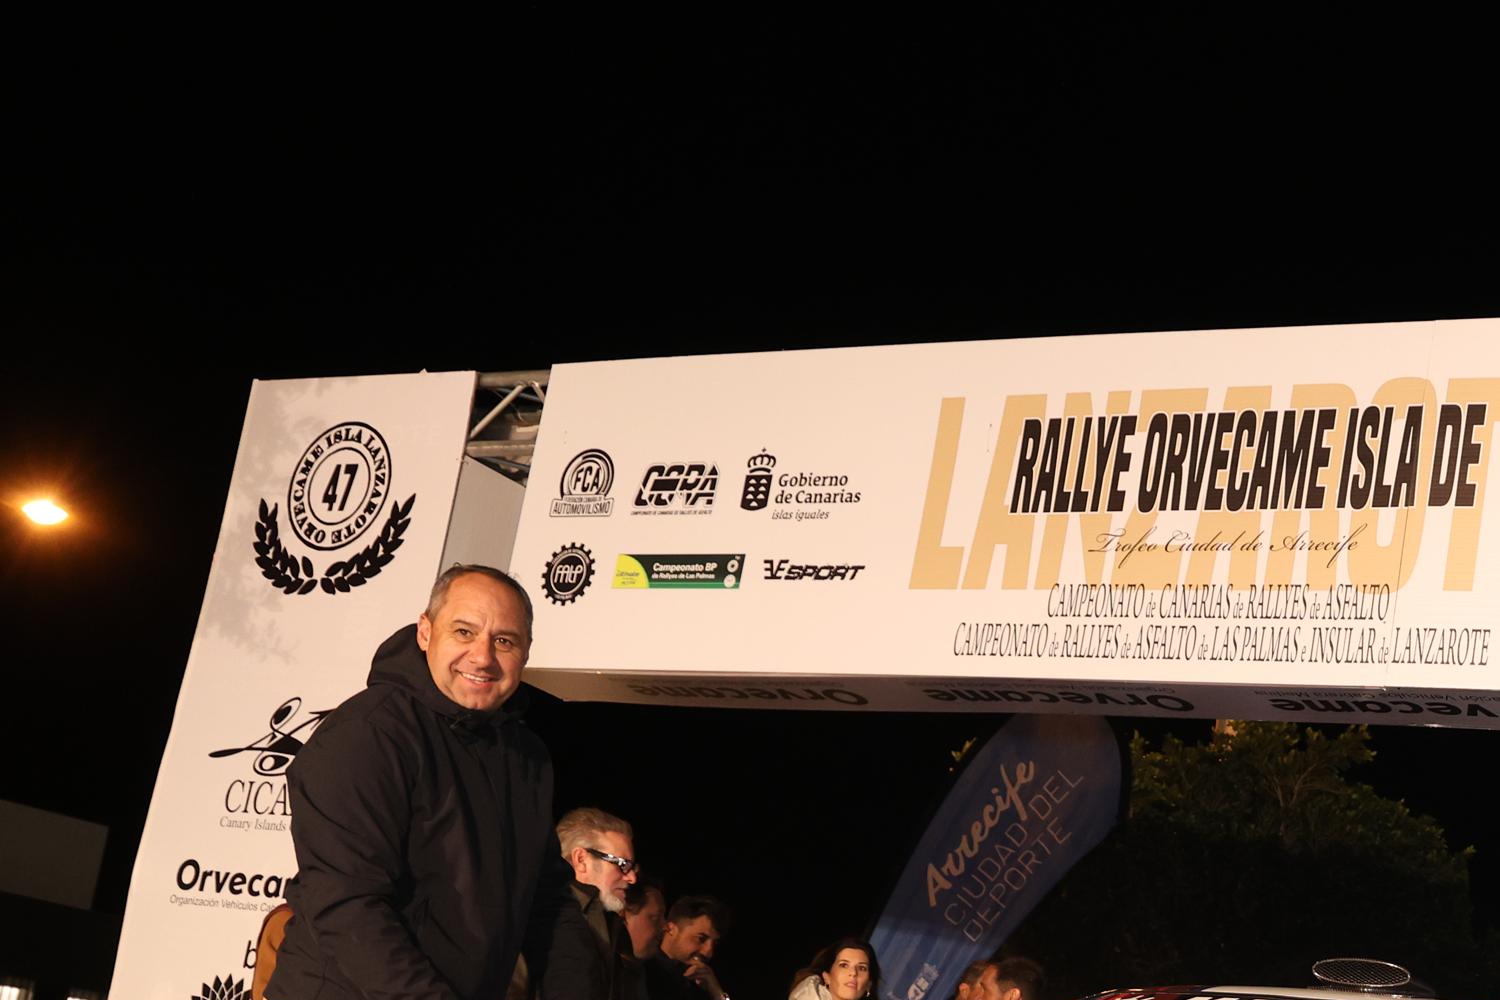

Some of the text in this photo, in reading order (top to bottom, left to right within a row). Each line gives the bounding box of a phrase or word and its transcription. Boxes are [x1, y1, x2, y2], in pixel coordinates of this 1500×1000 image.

[325, 428, 363, 449] ISLA
[1010, 402, 1488, 513] RALLYE ORVECAME ISLA DE
[322, 463, 359, 512] 47
[573, 465, 601, 493] FCA
[778, 472, 848, 488] Gobierno
[552, 500, 611, 514] AUTOMOVILISMO
[775, 488, 861, 504] de Canarias
[772, 509, 829, 521] islas iguales
[1088, 523, 1368, 569] Trofeo Ciudad de Arrecife
[652, 562, 718, 574] Campeonato BP
[1047, 583, 1391, 622] CAMPEONATO de CANARIAS de RALLYES de ASFALTO
[953, 622, 1049, 657] CAMPEONATO
[1049, 632, 1059, 657] de
[1060, 624, 1122, 660] RALLYES
[1121, 633, 1131, 659] de
[1132, 625, 1198, 661] ASFALTO
[1198, 635, 1208, 660] de
[1209, 626, 1240, 662] LAS
[1240, 626, 1301, 662] PALMAS
[1308, 627, 1376, 664] INSULAR
[1378, 637, 1389, 664] de
[1391, 627, 1491, 666] LANZAROTE
[626, 683, 870, 706] Orvecame
[922, 686, 1196, 712] Orvecame
[225, 779, 292, 817] CICA
[219, 816, 287, 833] Canary Islands
[926, 760, 1036, 907] Arrecife
[944, 769, 1085, 925] CIUDAD DEL
[176, 858, 290, 899] Orveca
[963, 817, 1072, 942] DEPORTE
